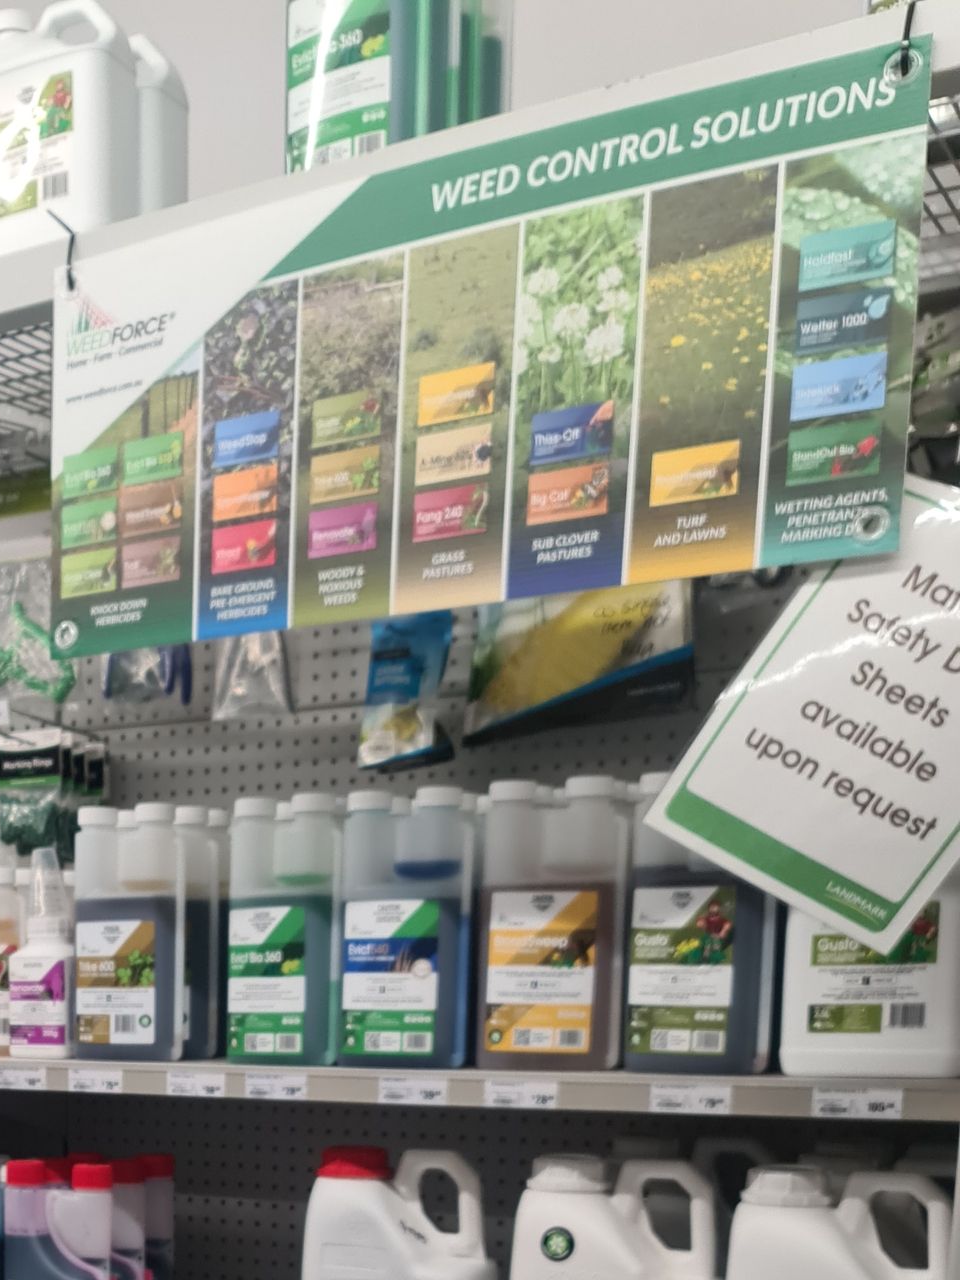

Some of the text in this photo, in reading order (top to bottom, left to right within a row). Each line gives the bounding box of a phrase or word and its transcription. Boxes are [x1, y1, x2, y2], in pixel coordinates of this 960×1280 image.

[431, 75, 900, 212] WEED CONTROL SOLUTIONS
[842, 313, 868, 329] 1000
[775, 494, 833, 516] WETTING
[416, 509, 442, 526] Fang
[676, 513, 708, 530] TURF
[531, 530, 600, 553] SUB CLOVER
[653, 526, 727, 548] AND LAWNS
[781, 523, 843, 545] MARKING
[432, 550, 466, 566] GRASS
[536, 546, 593, 565] PASTURES
[318, 566, 355, 582] WOODY
[422, 562, 474, 580] PASTURES
[211, 583, 233, 599] BARE
[318, 579, 364, 595] NOXIOUS
[90, 598, 148, 618] KNOCK DOWN
[209, 590, 277, 610] PRE-EMERGENT
[323, 592, 358, 607] WEEDS
[95, 611, 142, 627] HERBICIDES
[217, 604, 268, 622] HERBICIDES
[847, 598, 942, 663] Safety
[850, 660, 950, 729] Sheets
[800, 698, 938, 784] available
[745, 726, 939, 841] upon request
[825, 880, 888, 920] LANDMARK
[634, 932, 668, 948] Gusto
[816, 936, 860, 952] Gusto
[264, 950, 283, 964] 360
[96, 961, 115, 972] 600
